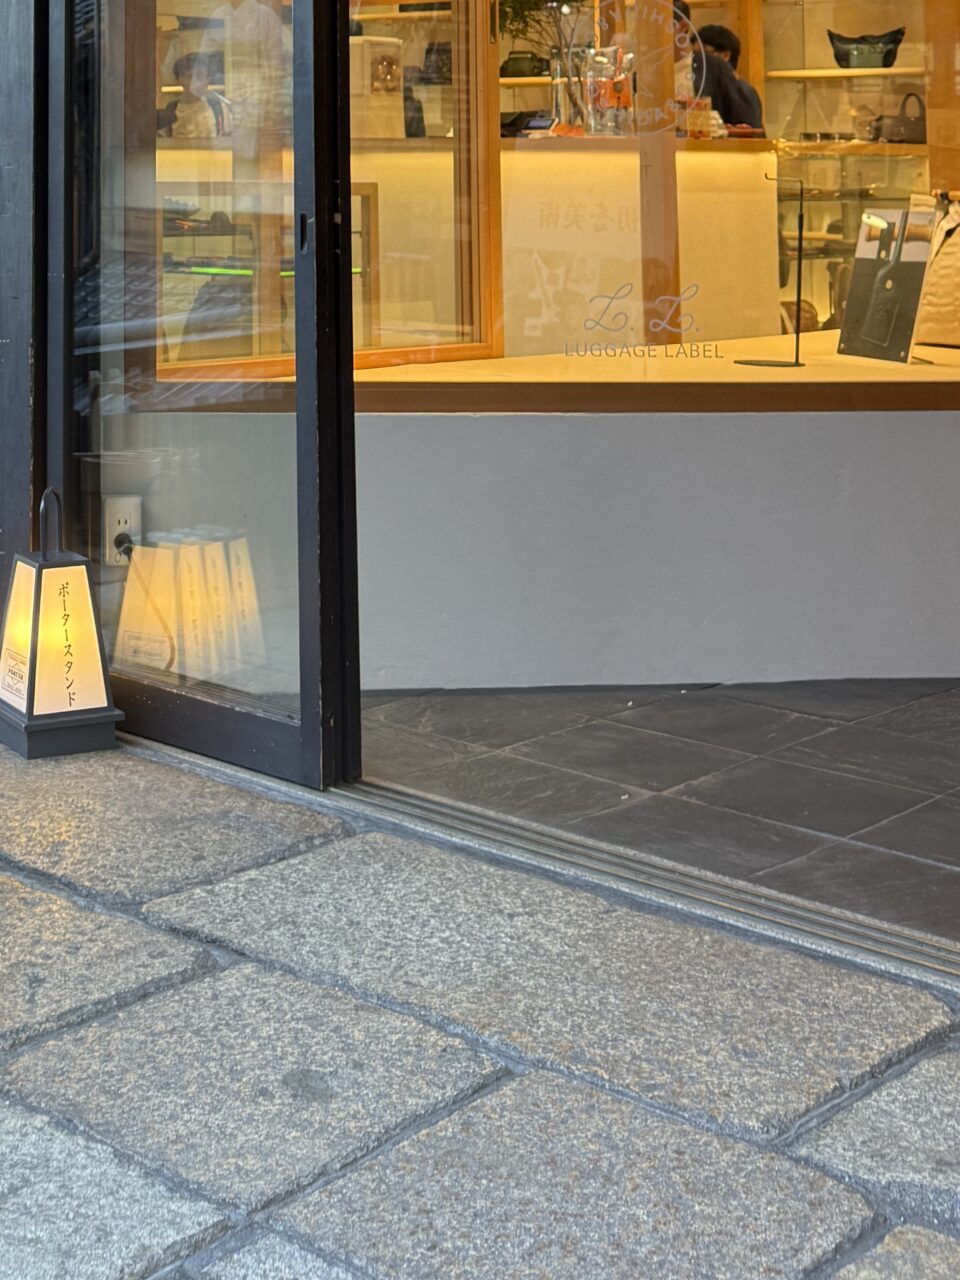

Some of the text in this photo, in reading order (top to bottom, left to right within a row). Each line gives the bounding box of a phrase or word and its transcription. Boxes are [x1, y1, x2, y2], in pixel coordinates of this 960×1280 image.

[564, 341, 724, 358] LUGGAGE LABEL
[58, 581, 76, 707] ポータースタンド
